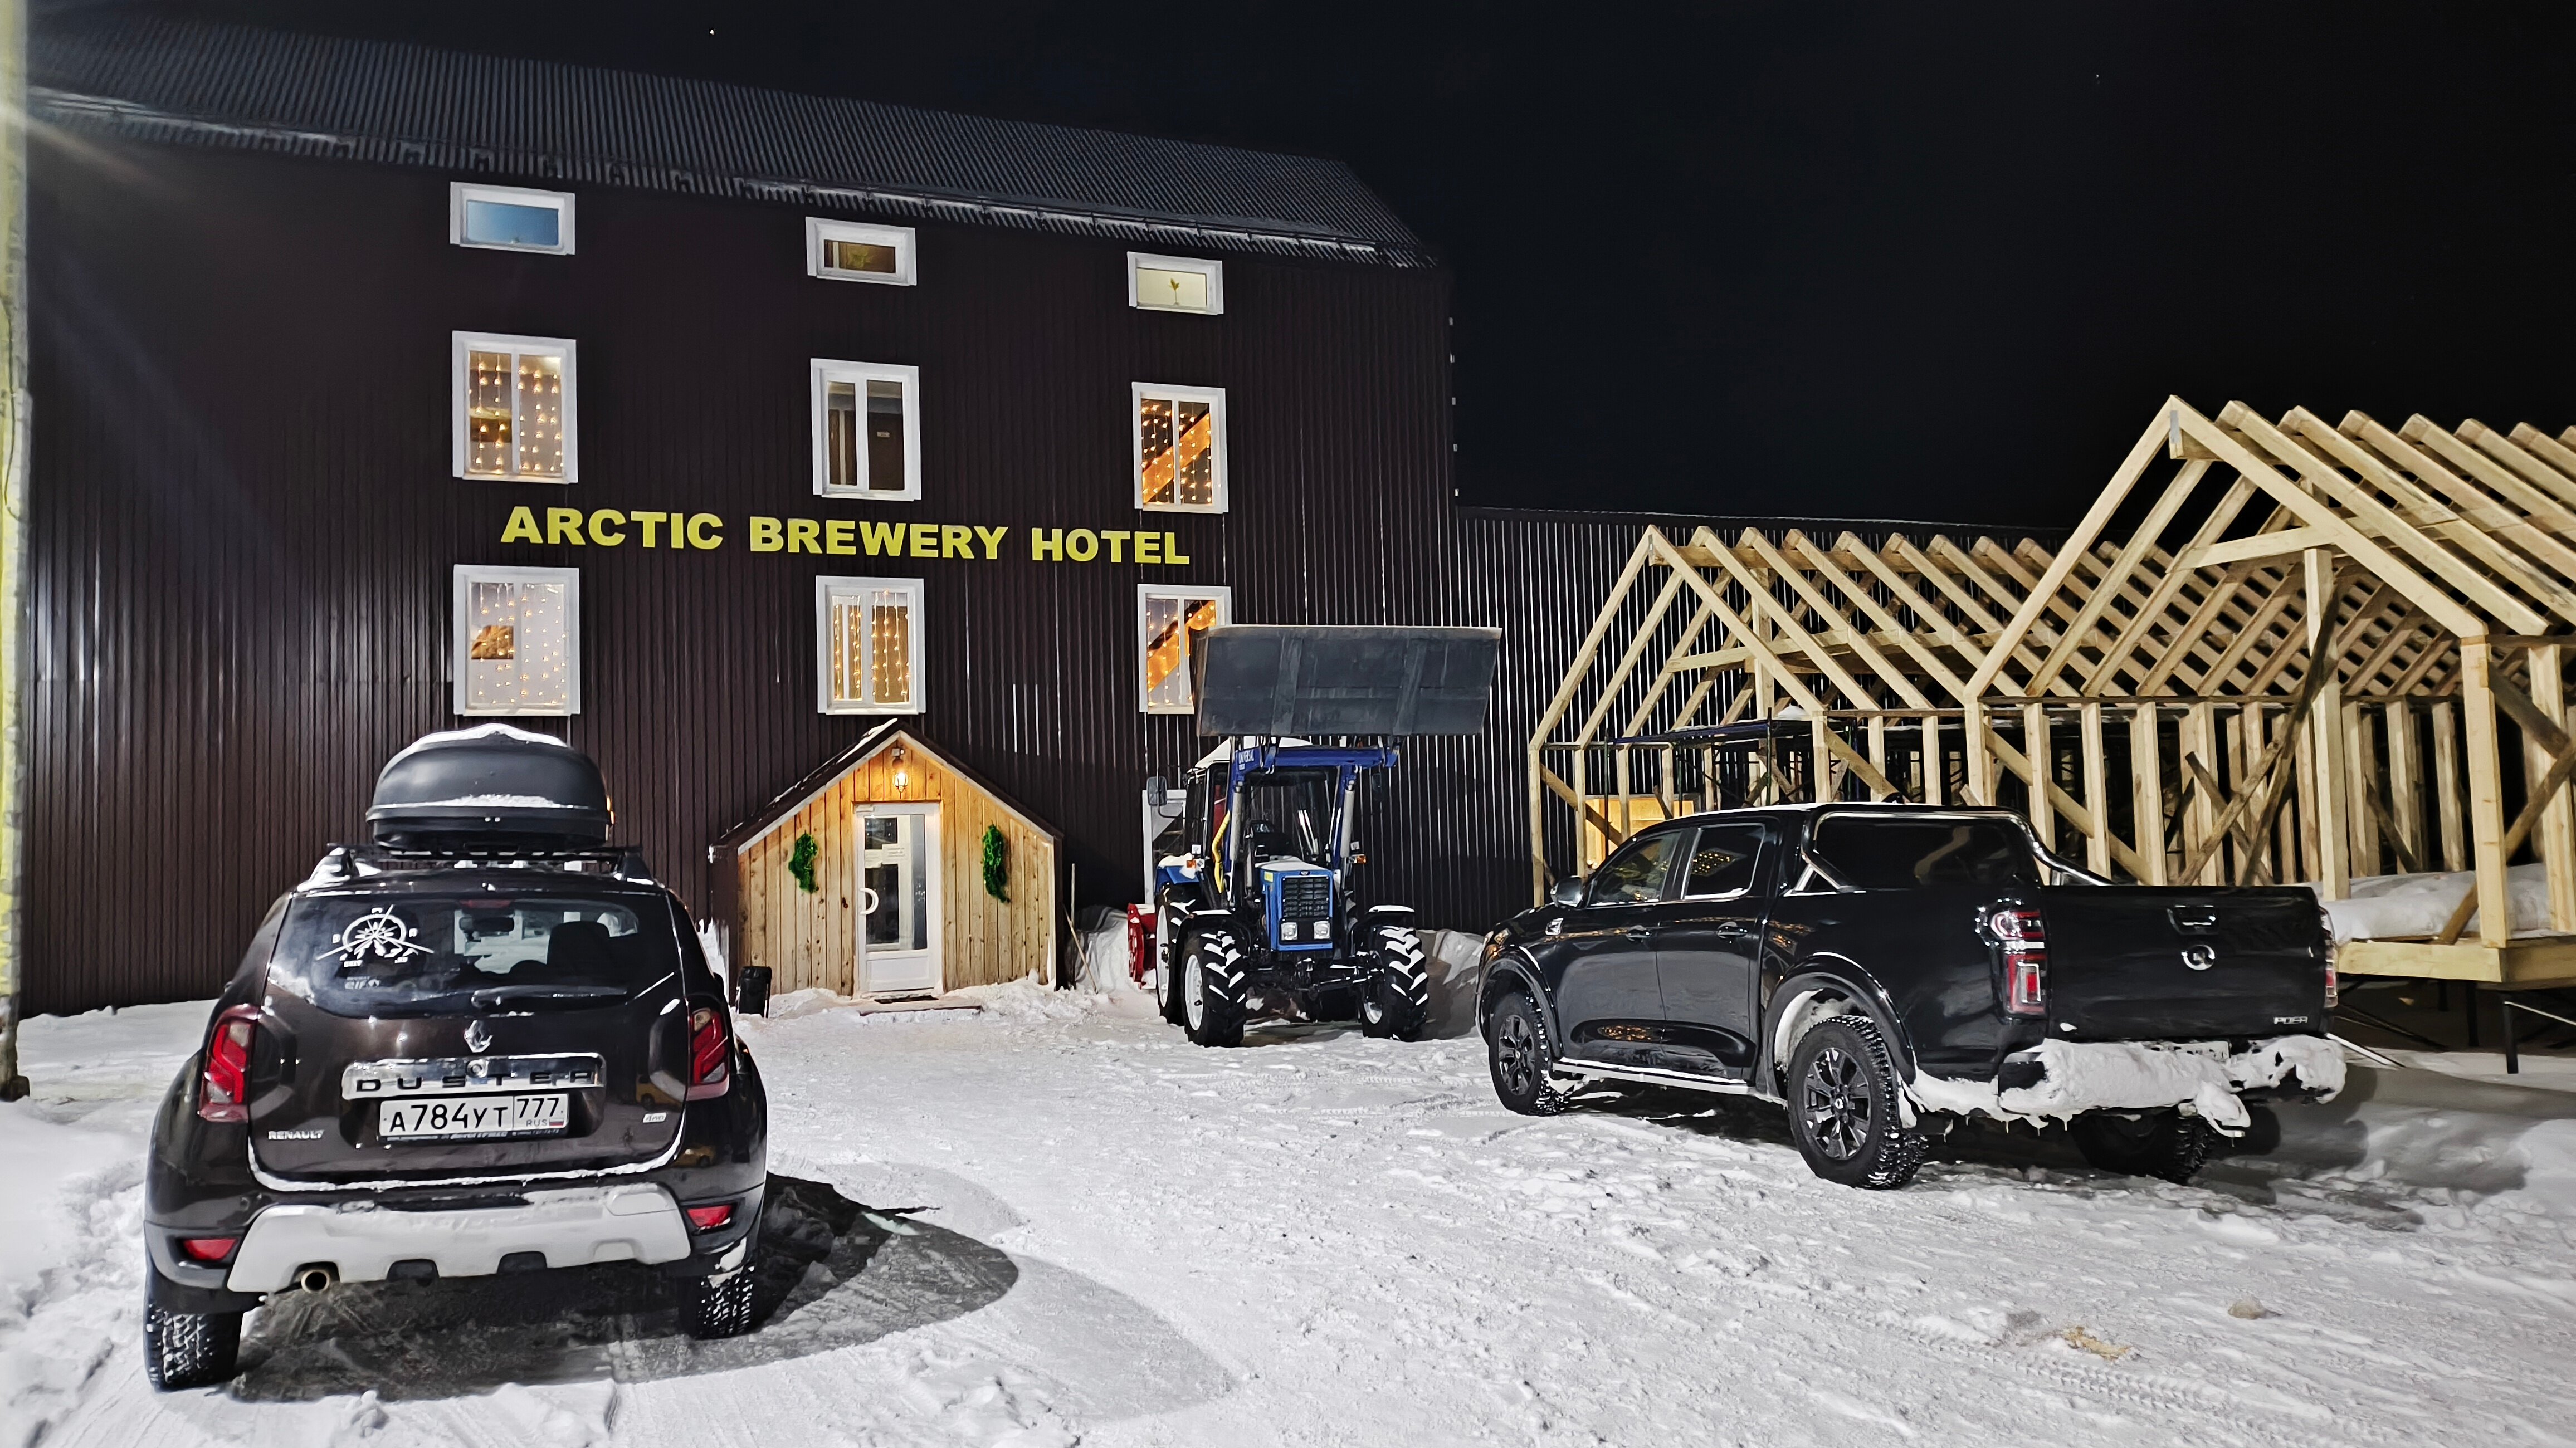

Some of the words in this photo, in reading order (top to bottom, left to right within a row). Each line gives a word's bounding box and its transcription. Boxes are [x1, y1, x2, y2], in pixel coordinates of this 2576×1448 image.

[501, 507, 723, 550] ARCTIC
[751, 517, 1007, 560] BREWERY
[1032, 529, 1189, 565] HOTEL
[357, 1072, 592, 1092] DUSTER
[516, 1097, 559, 1118] 777
[526, 1118, 548, 1127] RUS
[268, 1129, 325, 1140] RENAULT
